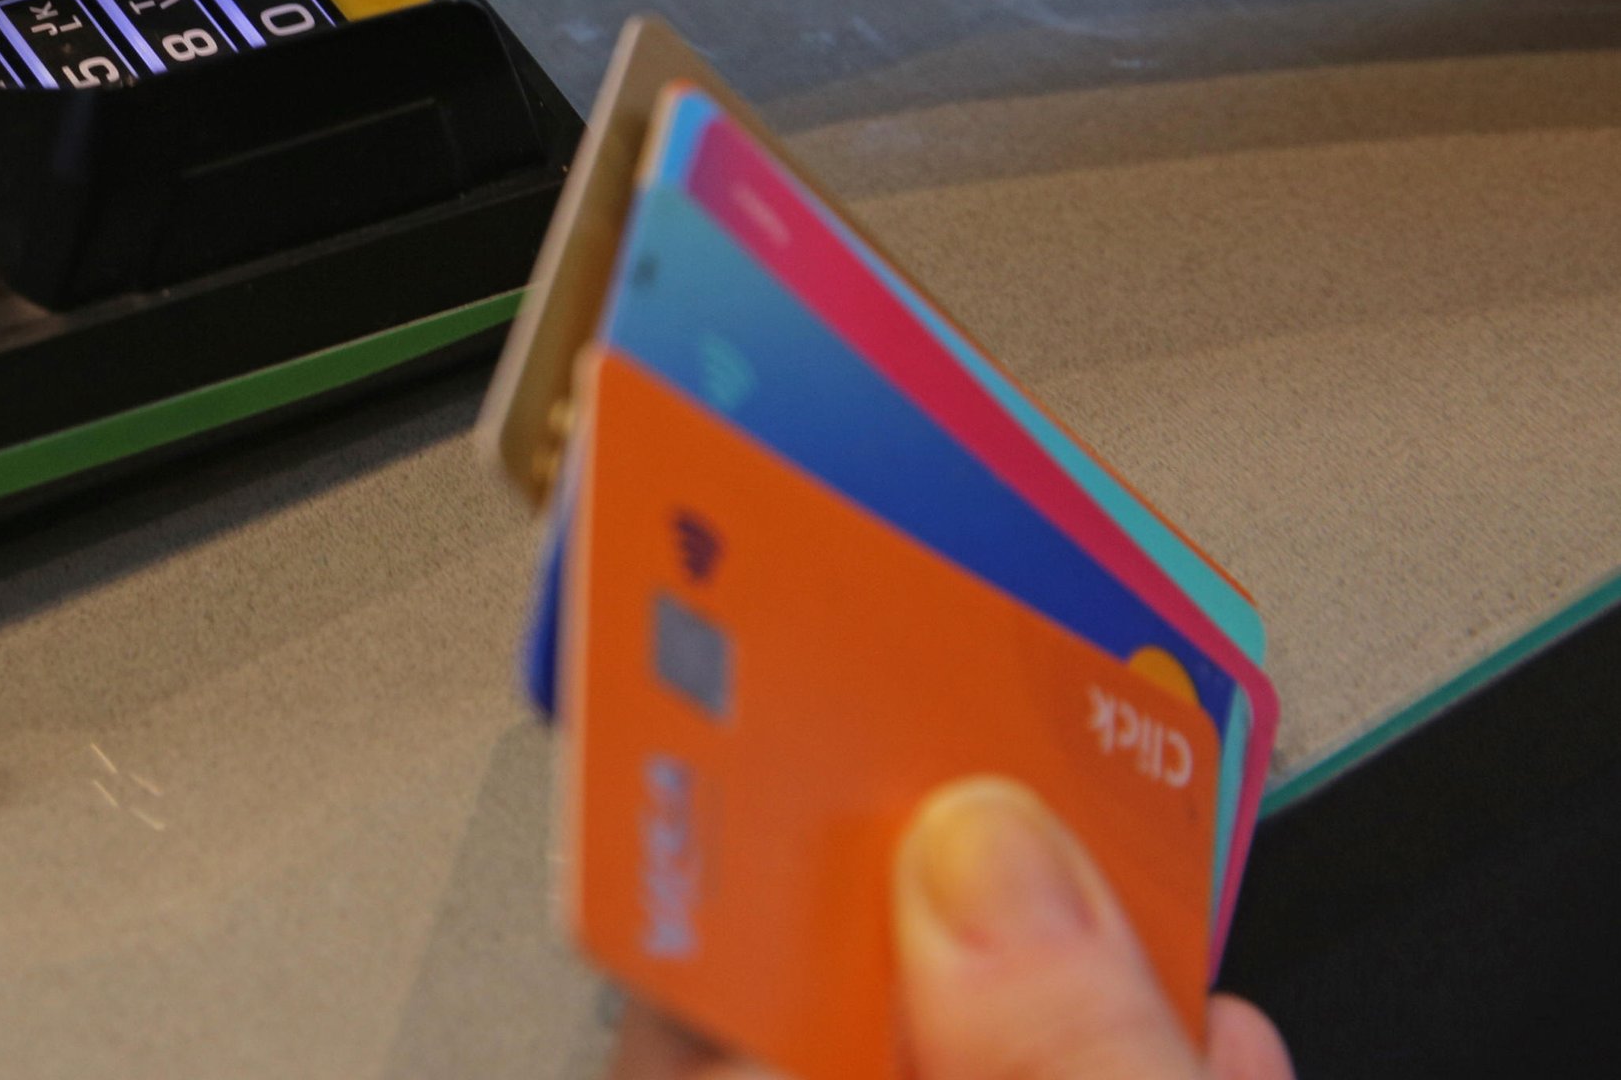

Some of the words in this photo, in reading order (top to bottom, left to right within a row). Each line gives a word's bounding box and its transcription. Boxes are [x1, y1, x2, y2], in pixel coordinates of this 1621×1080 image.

[260, 3, 316, 37] 0
[162, 28, 219, 63] 8
[61, 56, 121, 89] 5
[1089, 687, 1195, 788] Click
